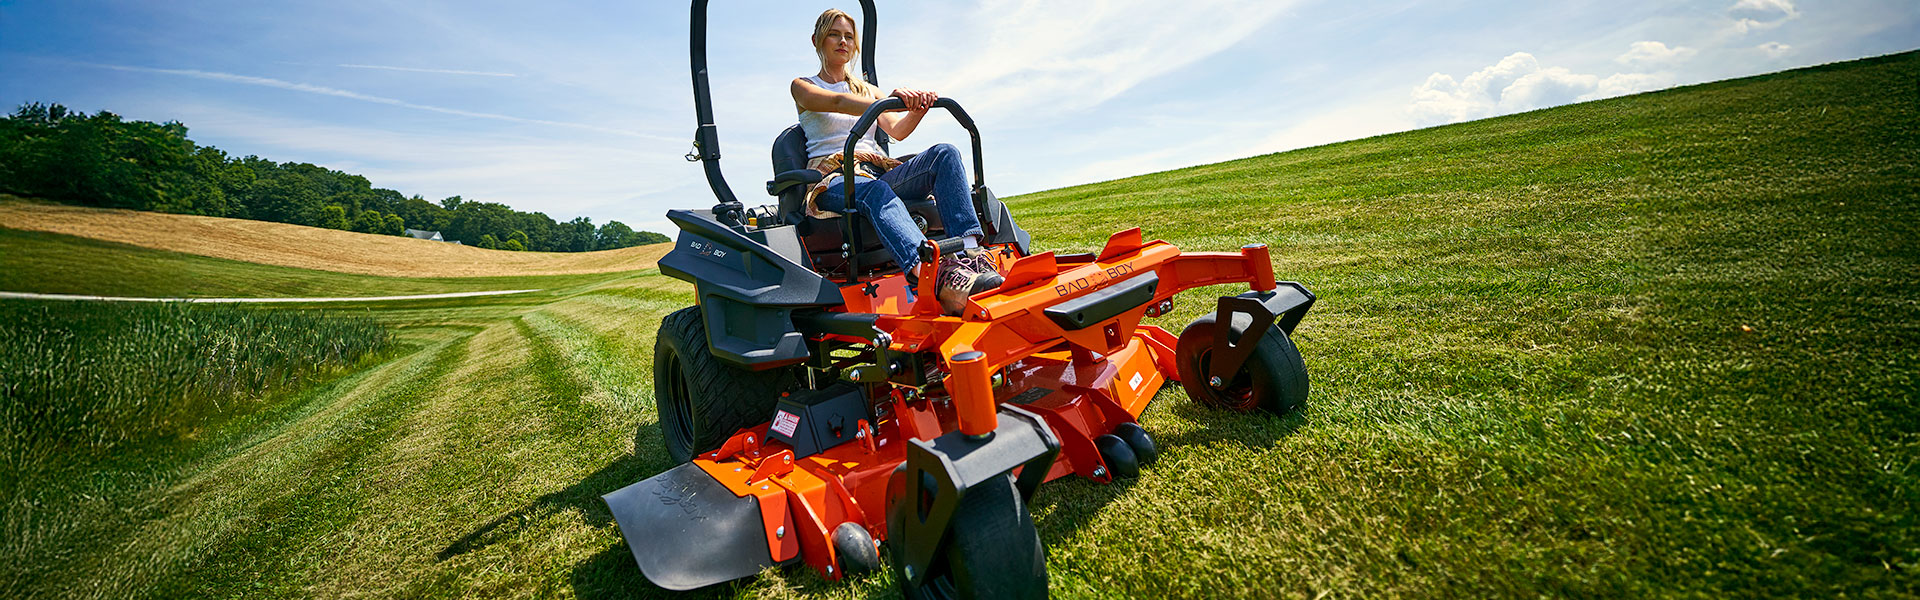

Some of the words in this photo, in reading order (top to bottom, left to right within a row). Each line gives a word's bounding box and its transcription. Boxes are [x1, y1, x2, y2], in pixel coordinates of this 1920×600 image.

[690, 241, 702, 250] BAD
[713, 249, 727, 258] BOY
[1055, 277, 1089, 297] BAD
[1106, 261, 1134, 279] BOY
